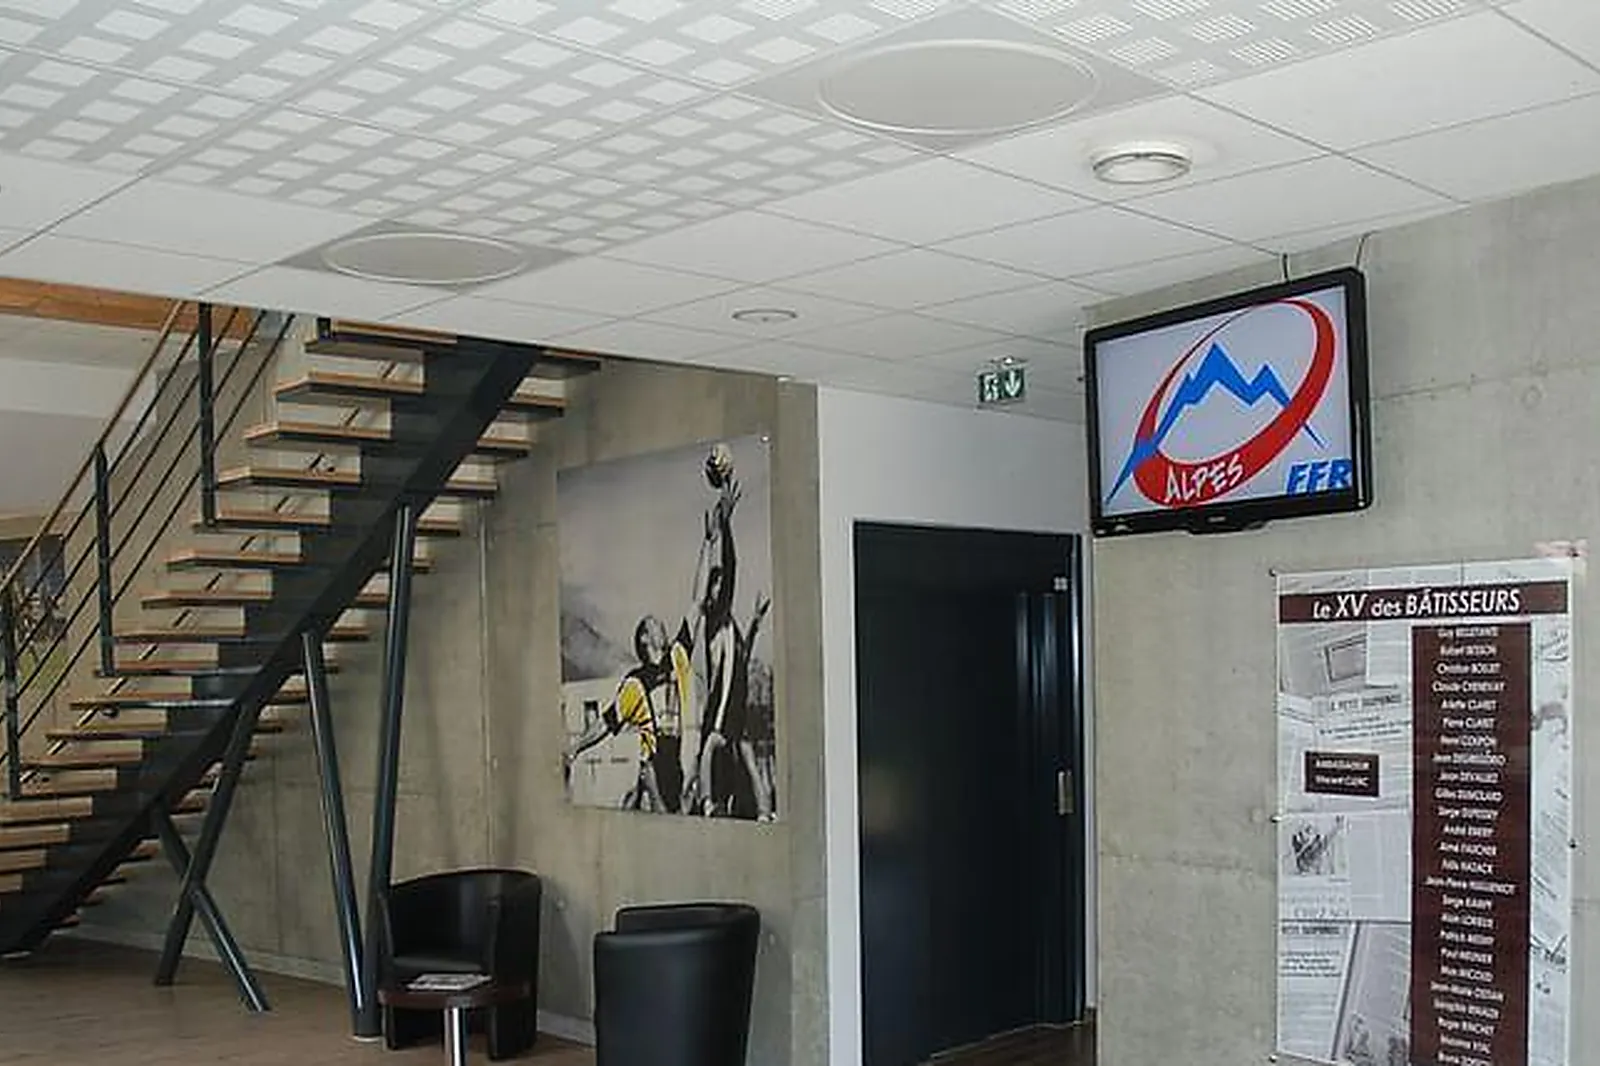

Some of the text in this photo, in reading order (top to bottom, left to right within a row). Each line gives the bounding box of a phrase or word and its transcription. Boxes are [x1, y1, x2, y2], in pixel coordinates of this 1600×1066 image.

[1164, 454, 1244, 504] ALPES
[1286, 458, 1352, 497] FFR
[1313, 588, 1521, 619] Le XV des BÂTISSEURS
